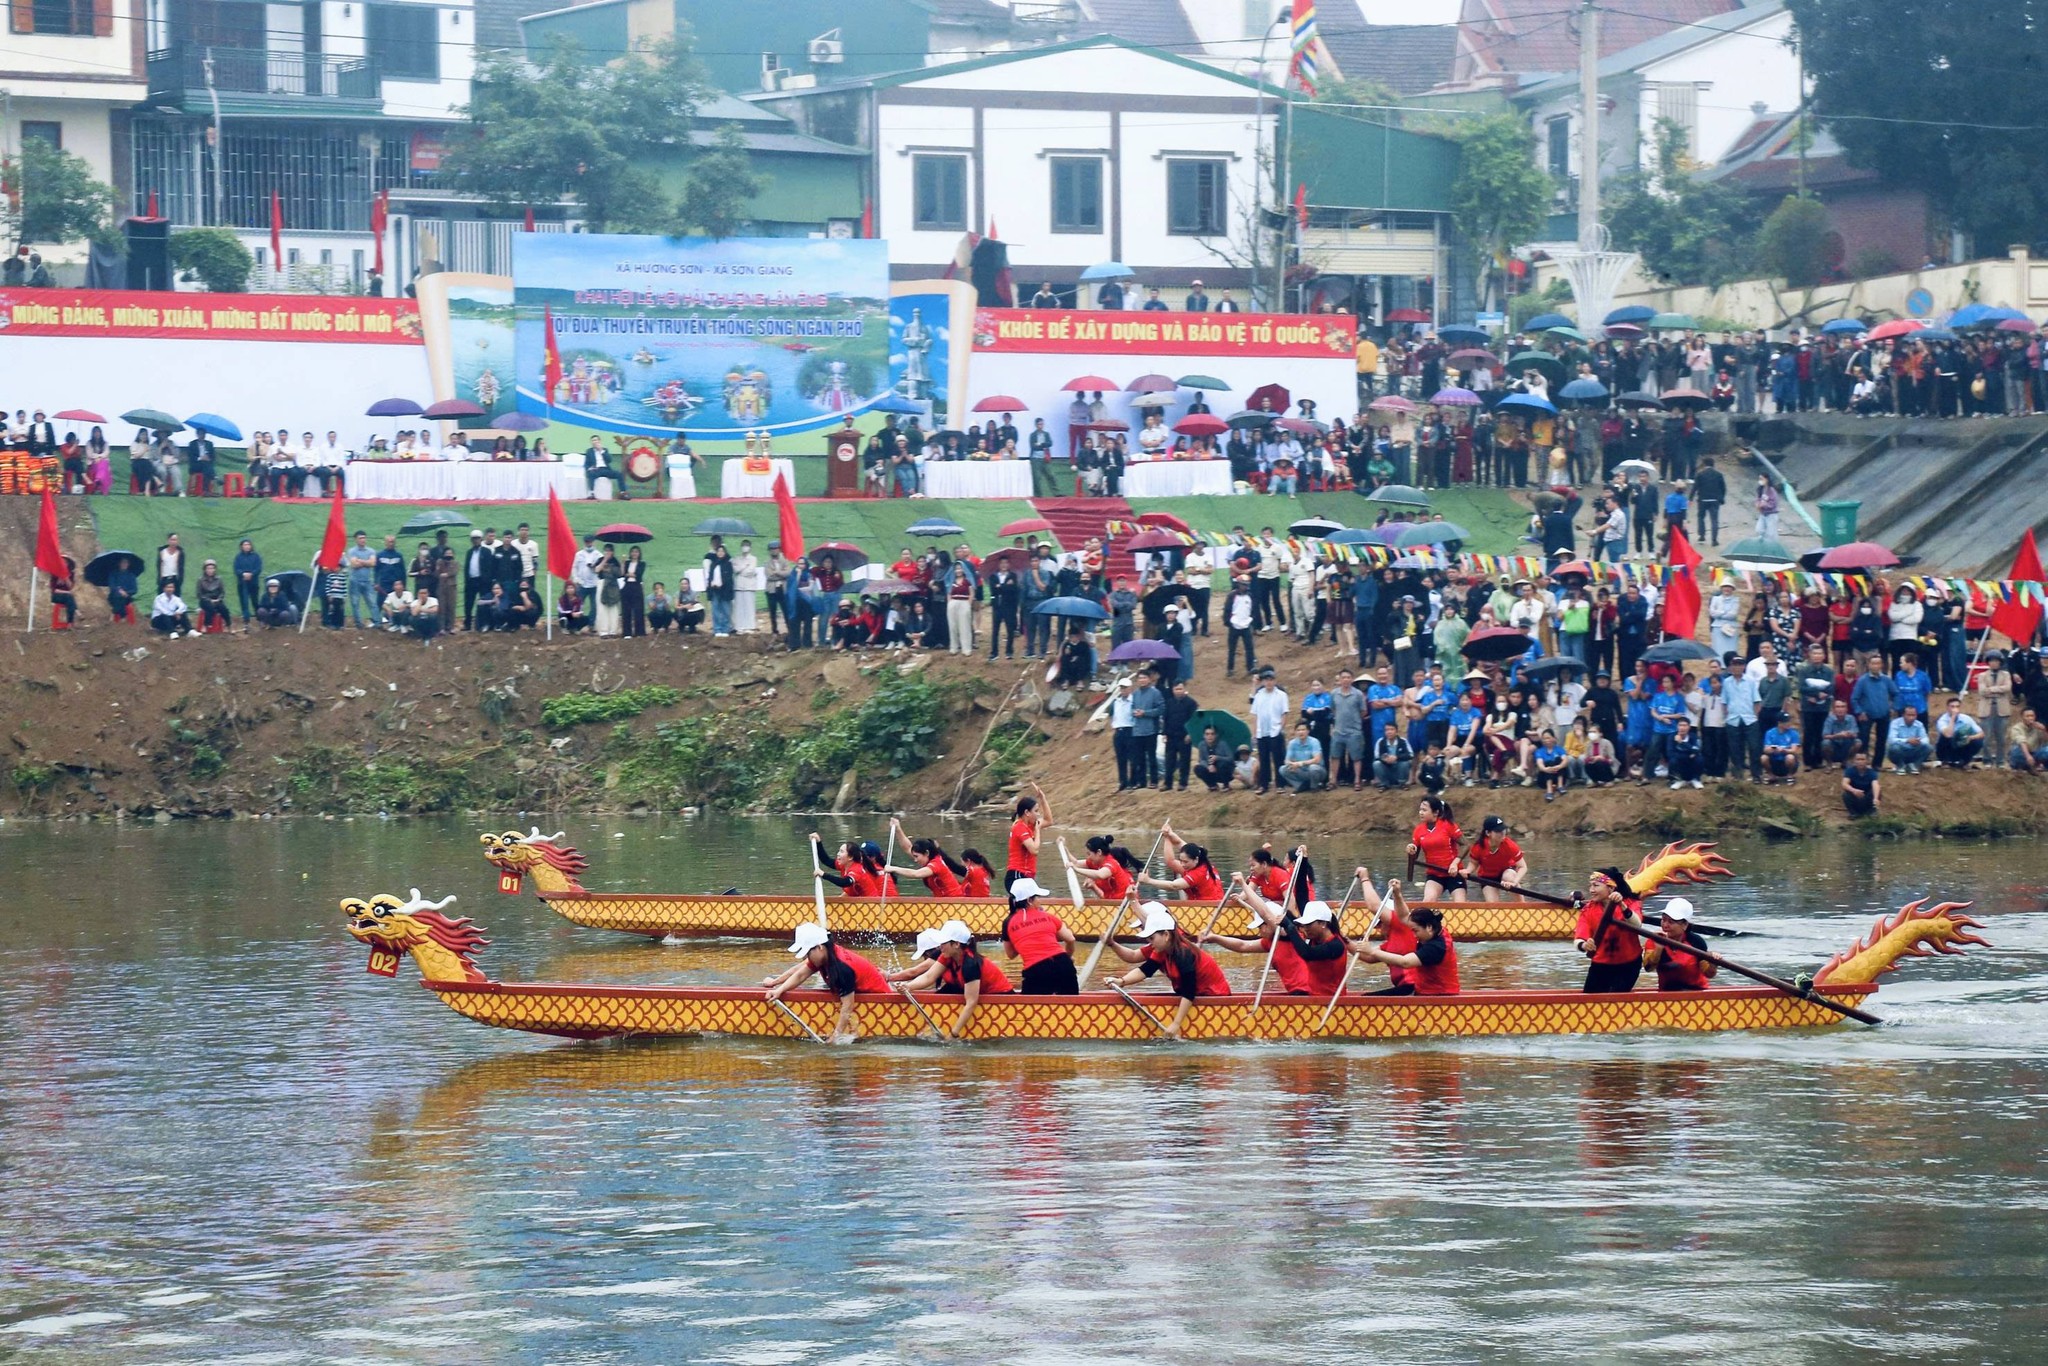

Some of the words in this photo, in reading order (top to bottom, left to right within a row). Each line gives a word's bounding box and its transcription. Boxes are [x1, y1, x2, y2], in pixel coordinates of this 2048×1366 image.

[634, 263, 677, 274] HƯƠNG
[680, 264, 703, 275] SƠN
[731, 265, 754, 275] SƠN
[758, 266, 793, 276] GIANG
[12, 301, 59, 325] MỪNG
[62, 299, 110, 328] ĐẢNG,
[113, 303, 159, 327] MỪNG
[162, 306, 209, 330] XUÂN,
[211, 306, 257, 330] MỪNG
[259, 305, 289, 330] ĐẤT
[291, 308, 332, 331] NƯỚC
[335, 307, 361, 332] ĐỔI
[363, 310, 393, 333] MỚI
[572, 317, 599, 334] ĐUA
[601, 312, 654, 334] THUYỀN
[657, 312, 707, 335] TRUYỀN
[711, 313, 754, 335] THỐNG
[757, 316, 793, 336] SÔNG
[999, 314, 1044, 340] KHỎE
[1047, 315, 1072, 340] ĐỂ
[1074, 319, 1108, 340] XÂY
[1111, 322, 1159, 344] DỰNG
[1161, 320, 1185, 341] VÀ
[1187, 317, 1223, 342] BẢO
[1226, 322, 1247, 346] VỆ
[1250, 319, 1273, 343] TỔ
[1275, 320, 1321, 345] QUỐC
[502, 876, 518, 892] 01
[370, 952, 397, 974] 02
